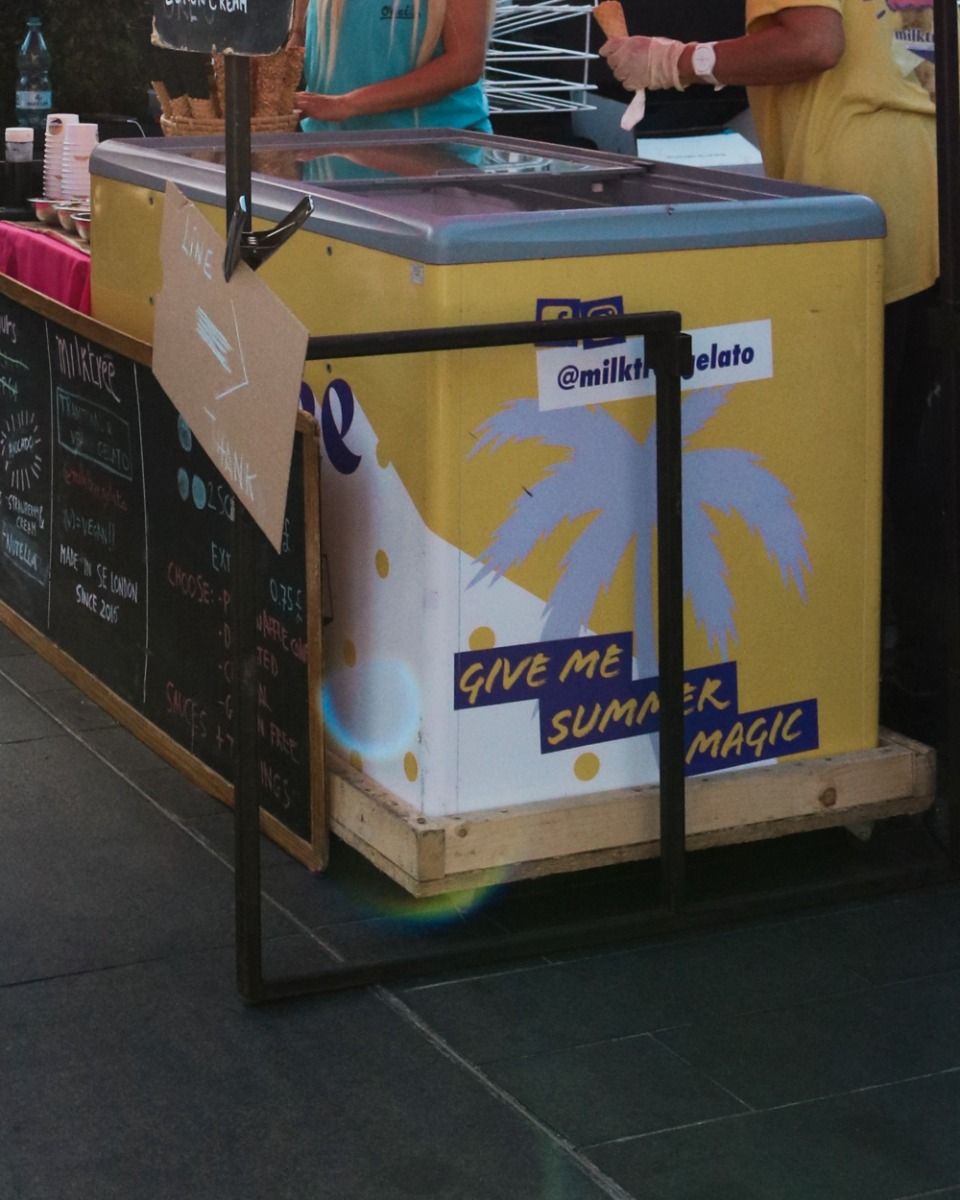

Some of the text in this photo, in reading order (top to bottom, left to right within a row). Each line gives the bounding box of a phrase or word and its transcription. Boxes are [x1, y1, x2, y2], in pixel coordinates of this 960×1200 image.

[110, 571, 139, 604] LONDON
[458, 644, 624, 705] GIVE ME
[684, 708, 804, 765] MAGIC
